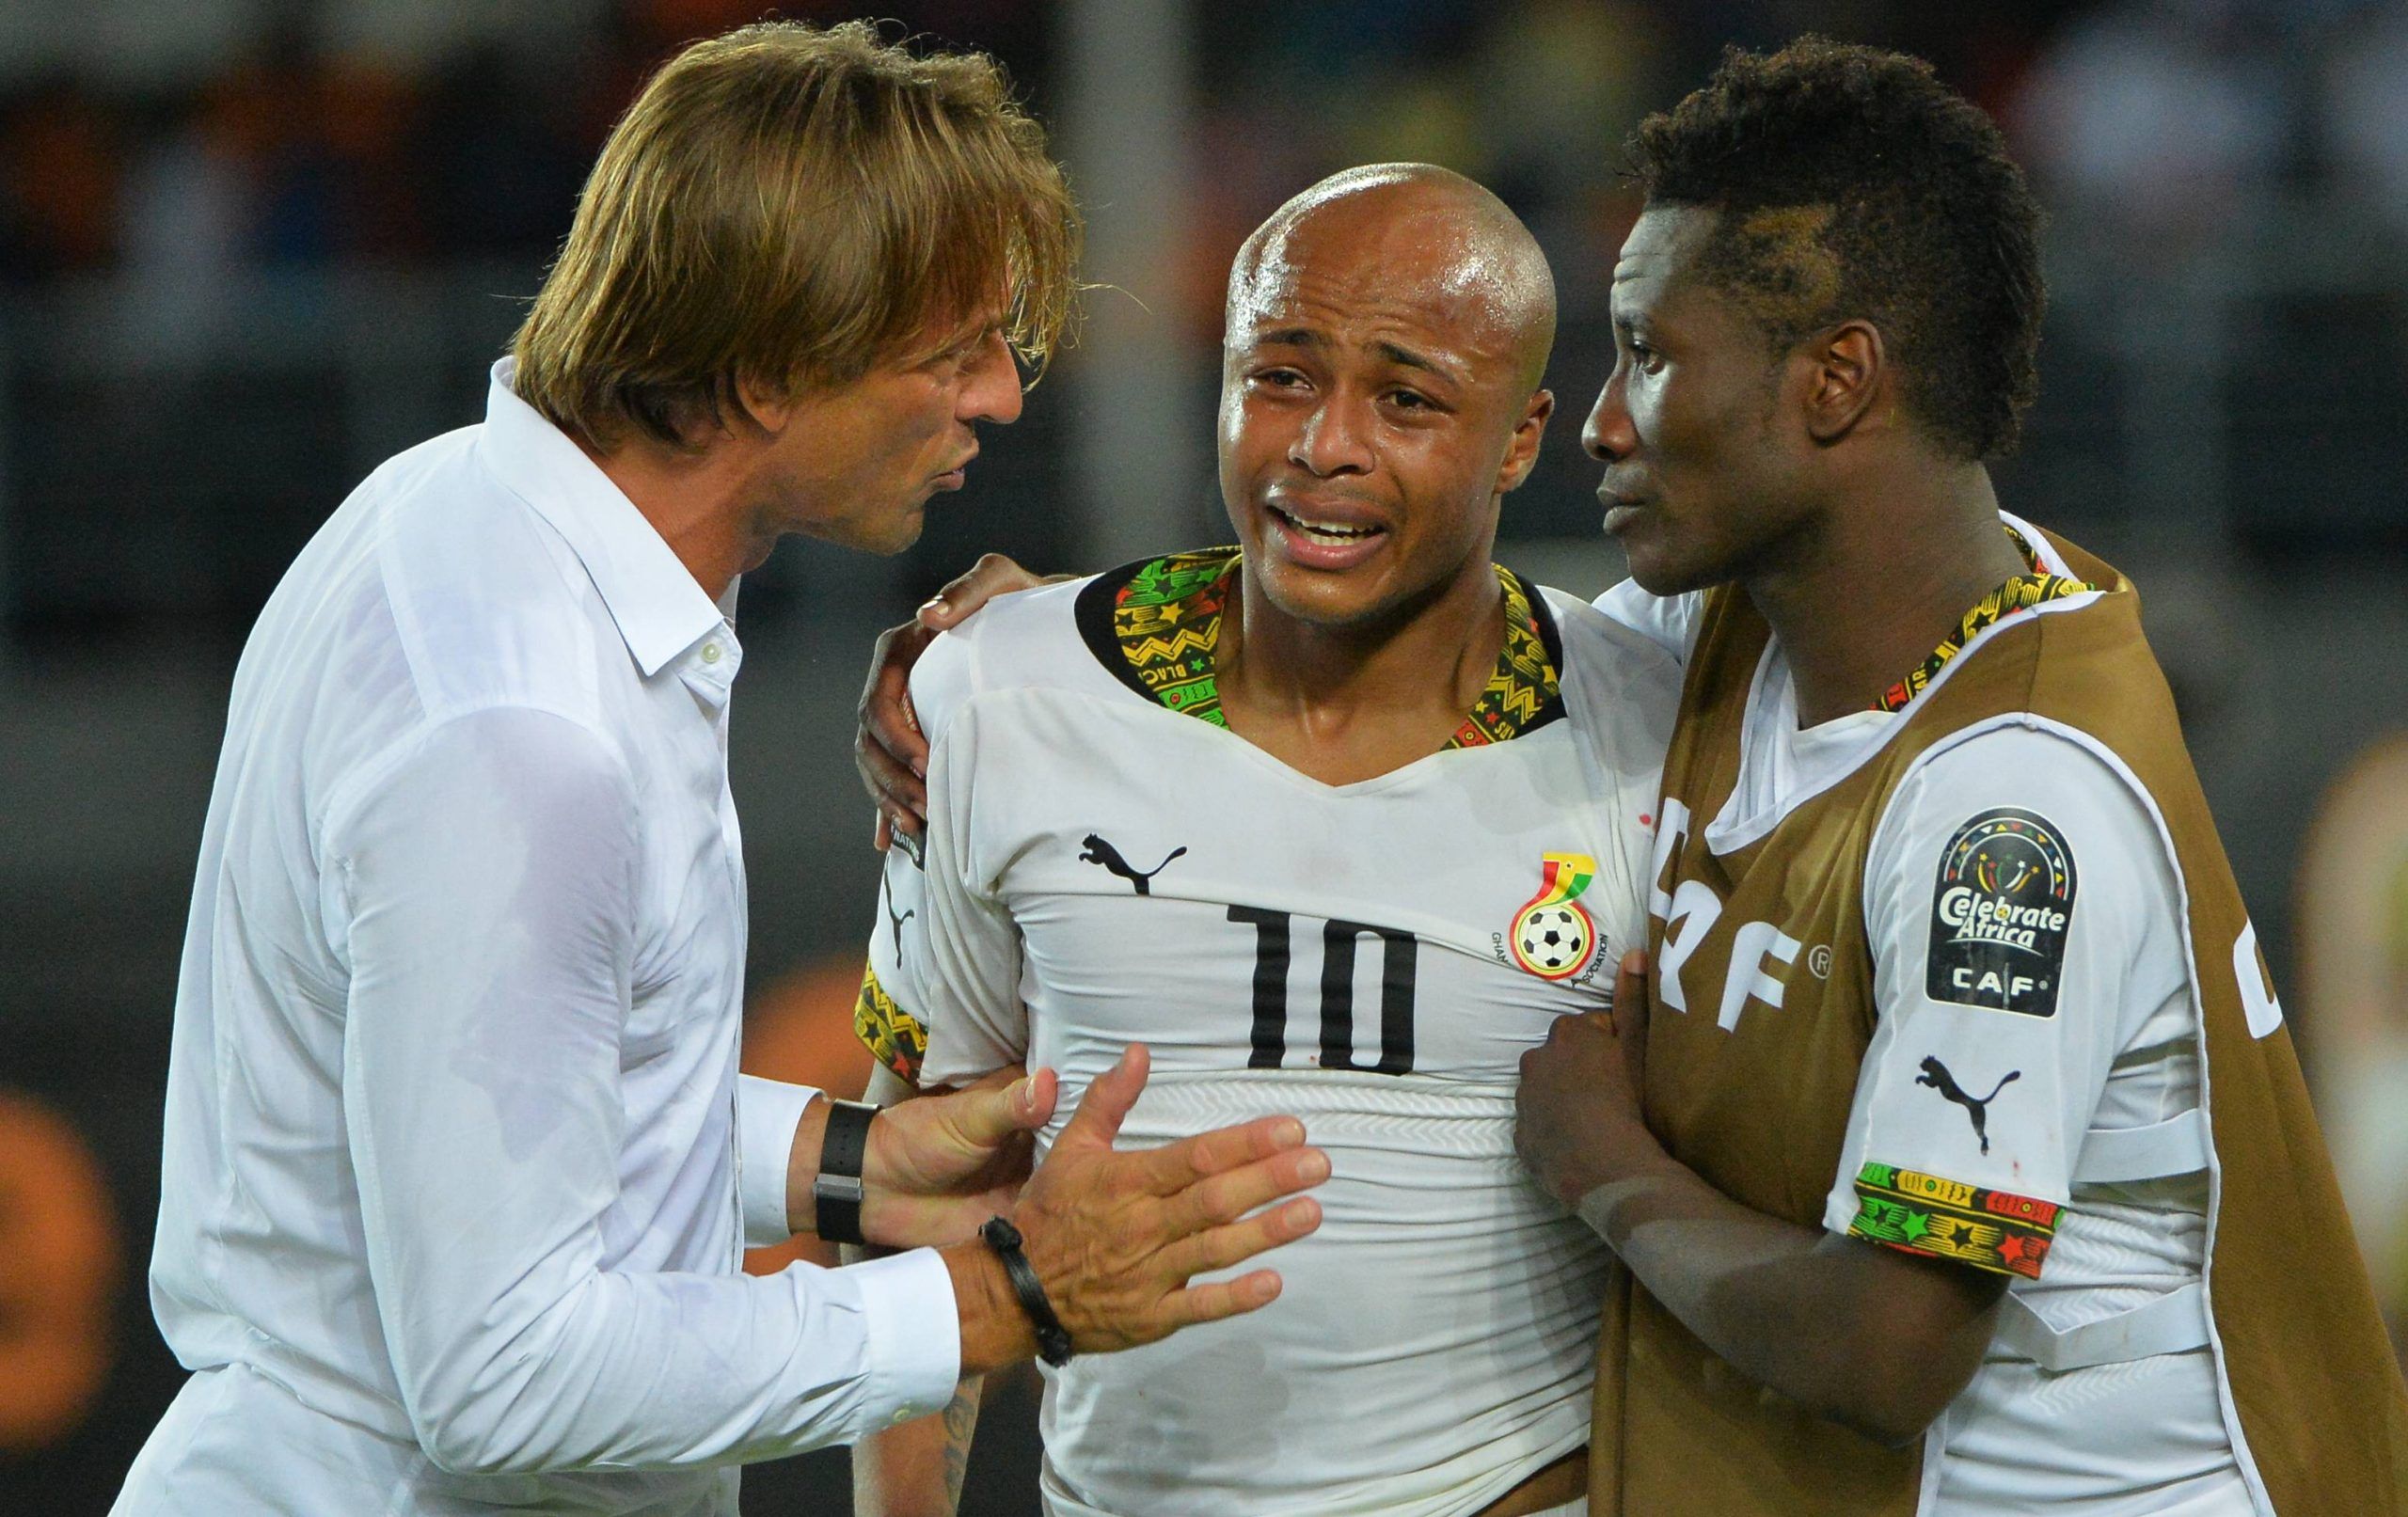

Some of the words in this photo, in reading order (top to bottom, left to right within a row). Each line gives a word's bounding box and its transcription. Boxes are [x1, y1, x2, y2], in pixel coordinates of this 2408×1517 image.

[1940, 887, 2066, 932] Celebrate
[1492, 932, 1509, 963] GHAN
[1955, 915, 2036, 949] Africa
[1227, 904, 1418, 1076] 10
